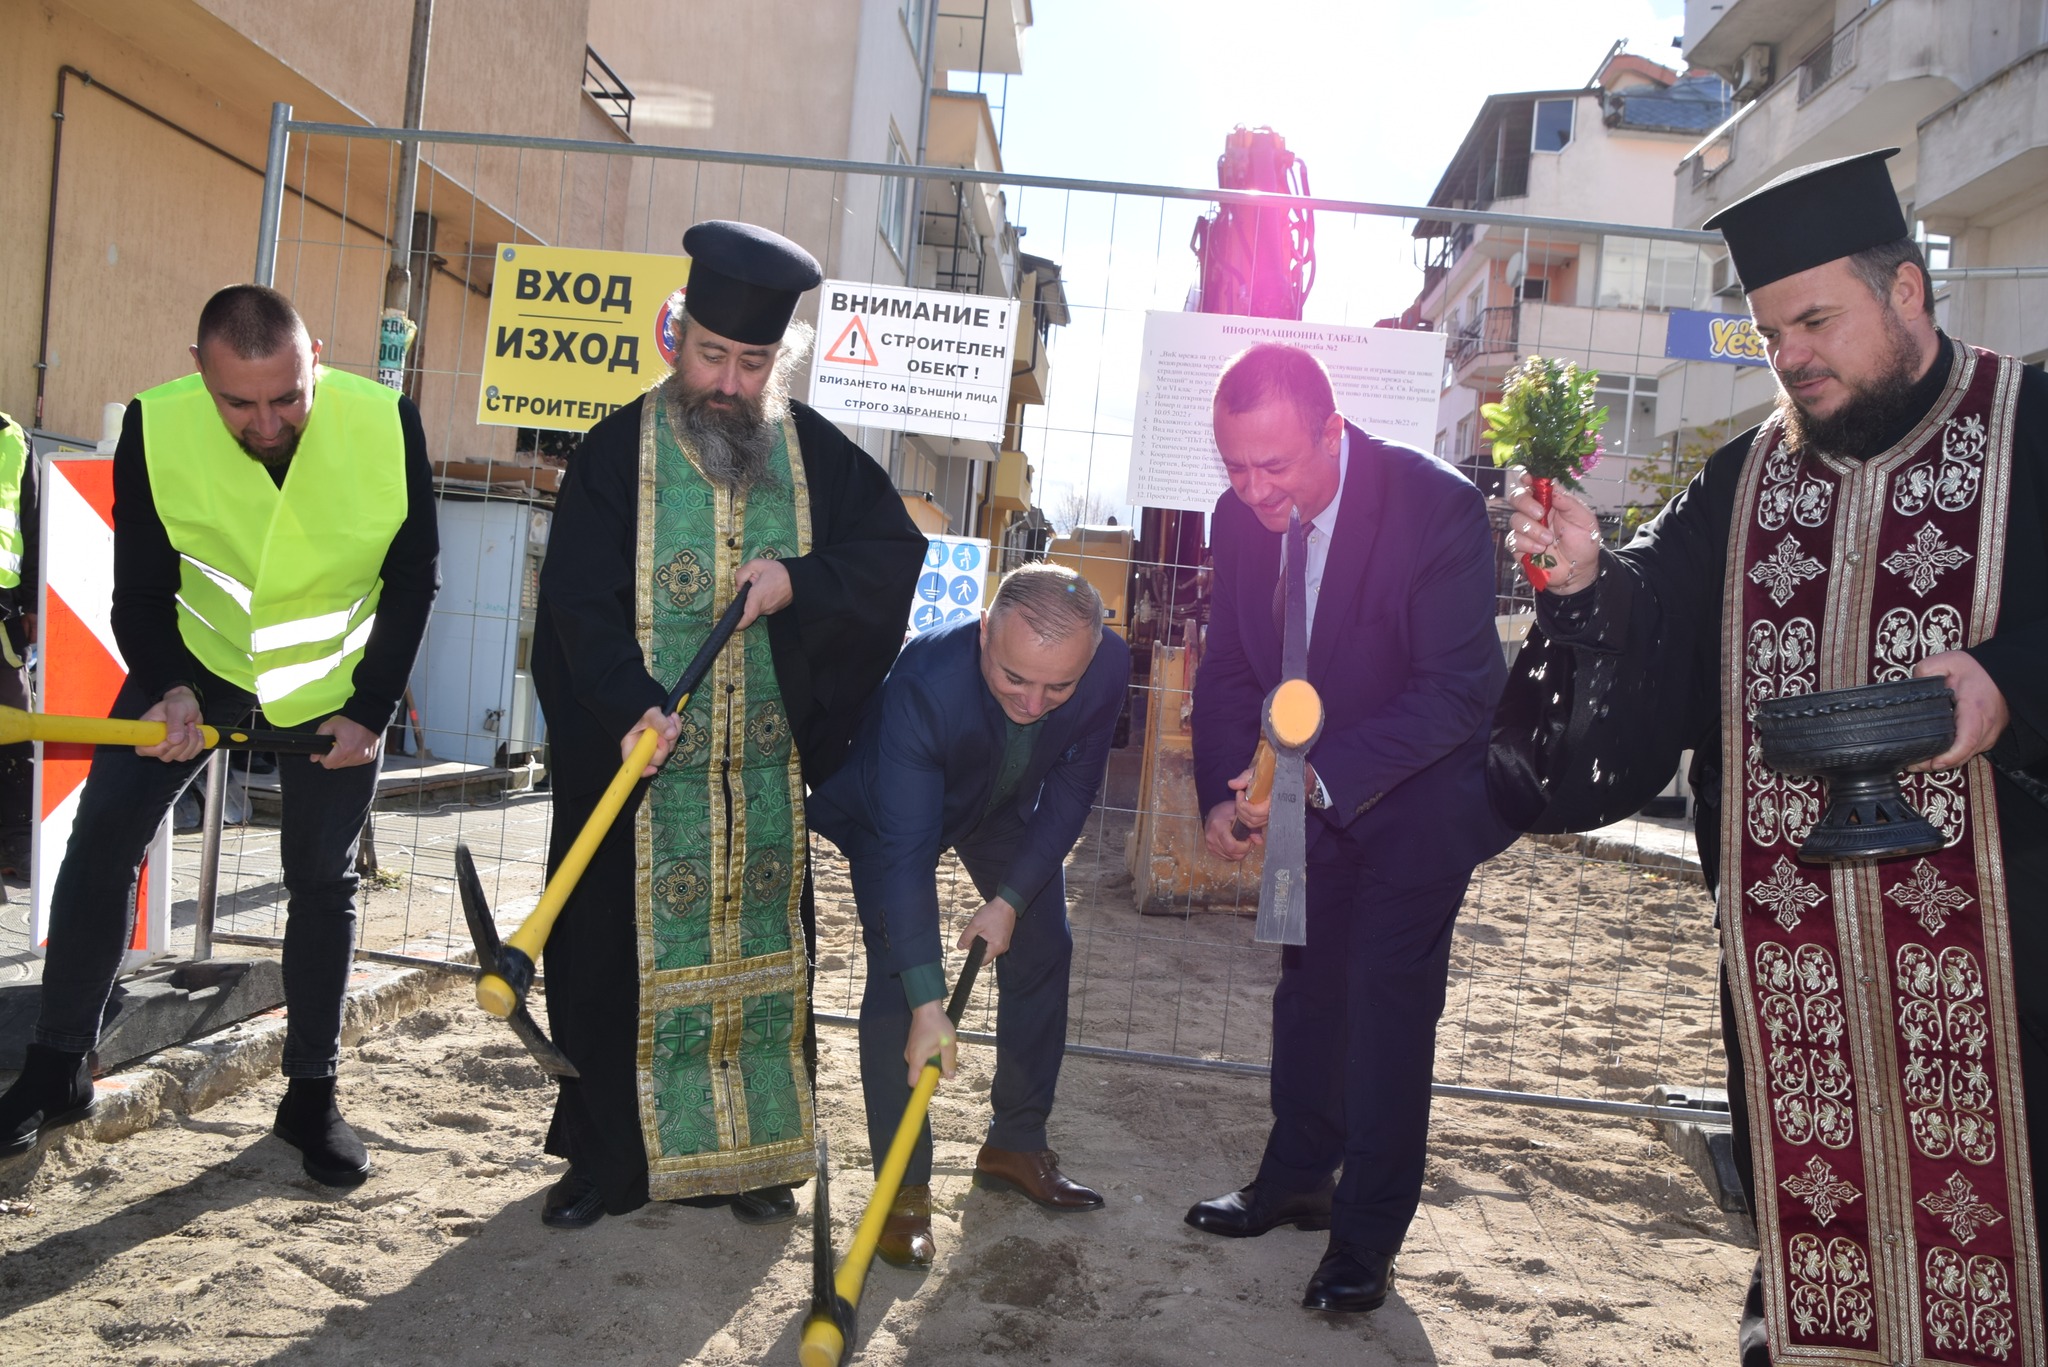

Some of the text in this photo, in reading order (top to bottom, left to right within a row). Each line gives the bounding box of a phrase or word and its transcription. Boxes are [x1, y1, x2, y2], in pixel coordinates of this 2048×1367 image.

[515, 268, 632, 314] ВХОД
[830, 292, 1006, 329] ВНИМАНИЕ !
[881, 333, 1006, 358] СТРОИТЕЛЕН
[1222, 325, 1369, 344] ИНФОРМАЦИОННА ТАБЕЛА
[495, 326, 639, 374] ИЗХОД
[907, 360, 979, 379] ОБЕКТ !
[819, 375, 998, 404] ВЛИЗАНЕТО НА ВЪНШНИ ЛИЦА
[844, 399, 889, 412] СТРОГО
[892, 405, 961, 421] ЗАБРАНЕНО
